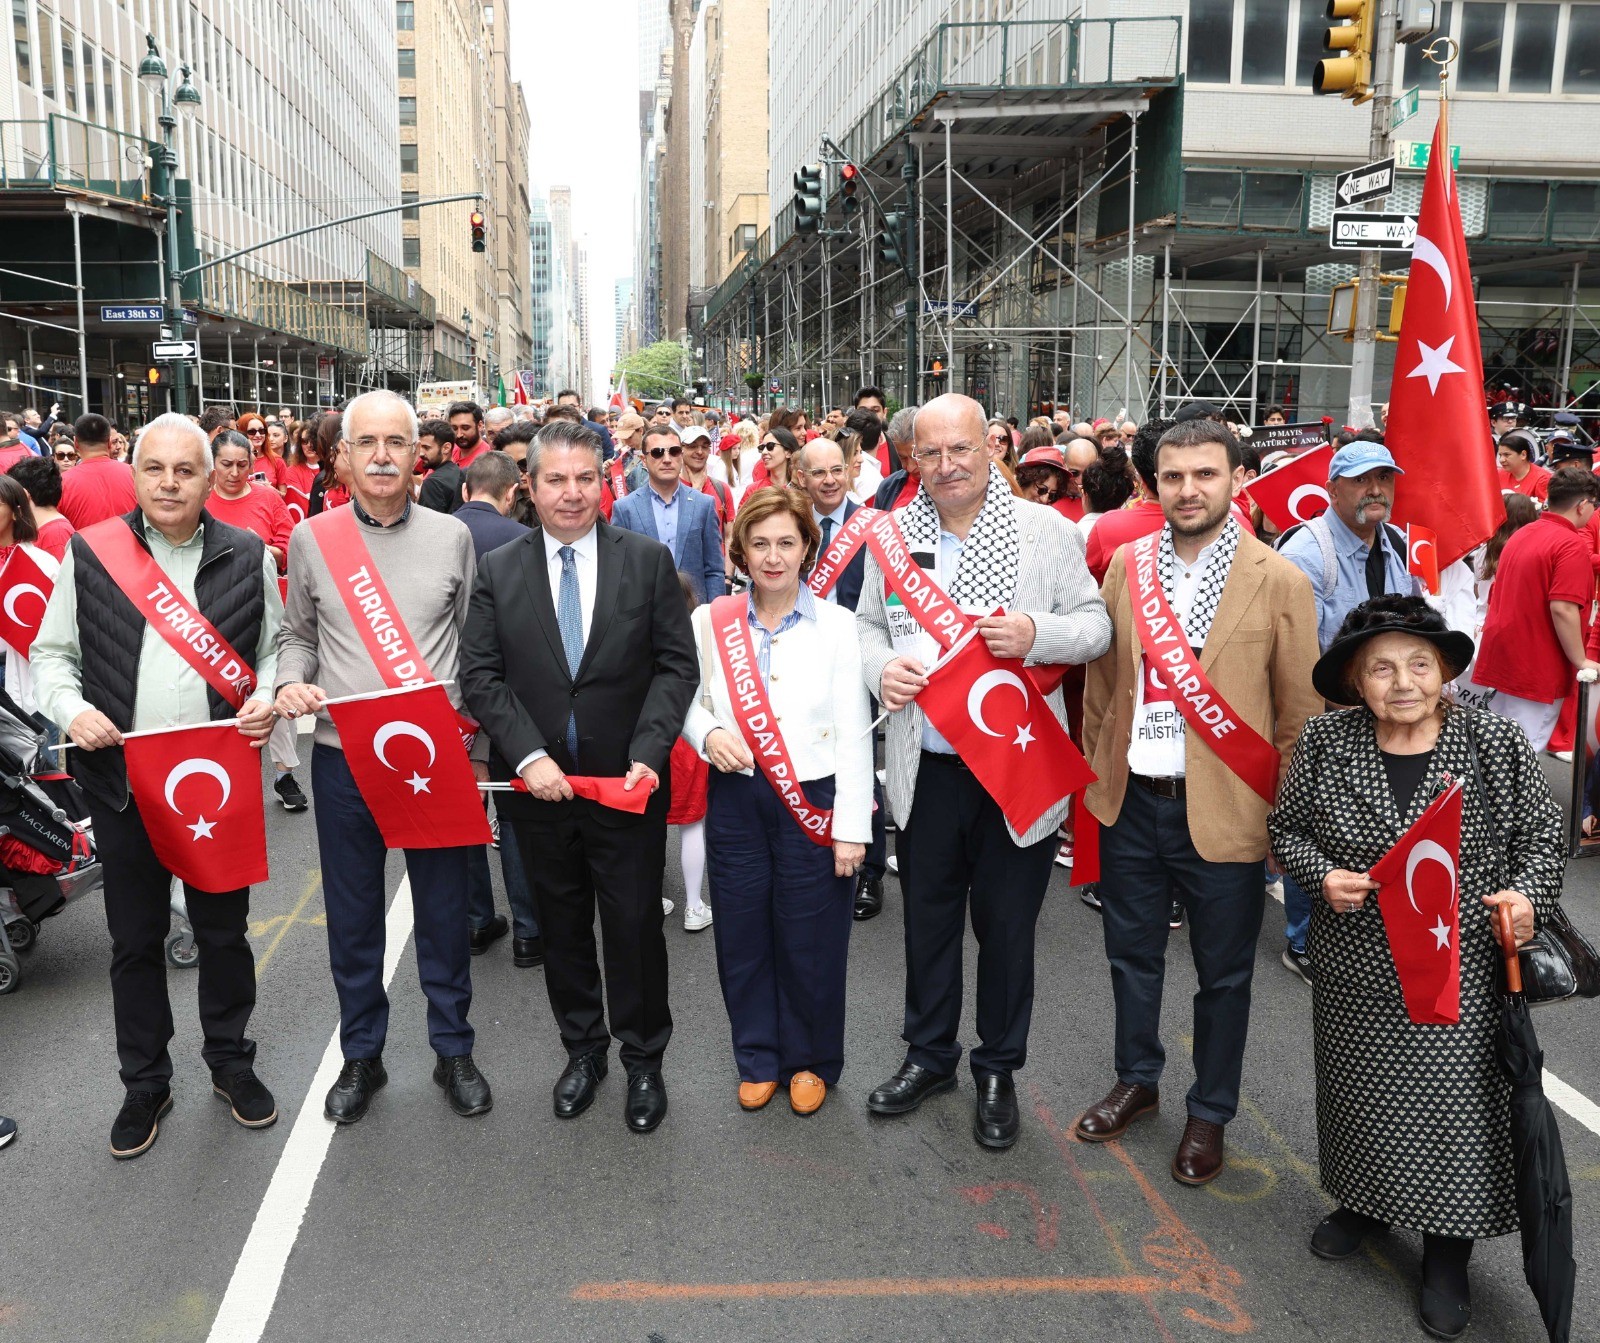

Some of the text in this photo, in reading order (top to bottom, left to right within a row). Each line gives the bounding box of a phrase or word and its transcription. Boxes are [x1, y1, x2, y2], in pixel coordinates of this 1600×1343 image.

[1411, 145, 1419, 165] E
[1344, 180, 1360, 196] ONE
[1368, 171, 1386, 189] WAY
[1341, 224, 1416, 238] ONE WAY
[105, 309, 160, 319] East 38th St
[965, 306, 974, 315] St
[53, 358, 80, 376] CHAS
[1268, 429, 1303, 438] 19 MAYIS
[1300, 437, 1324, 445] ANMA
[827, 532, 854, 565] DAY
[872, 514, 910, 580] URKISH
[902, 571, 944, 614] DAY
[146, 581, 227, 667] TURKISH
[347, 565, 408, 661] TURKISH
[1142, 597, 1178, 645] DAY
[1161, 646, 1237, 739] PARADE
[722, 618, 762, 712] TURKISH
[746, 712, 781, 758] DAY
[19, 810, 71, 851] MACLAREN
